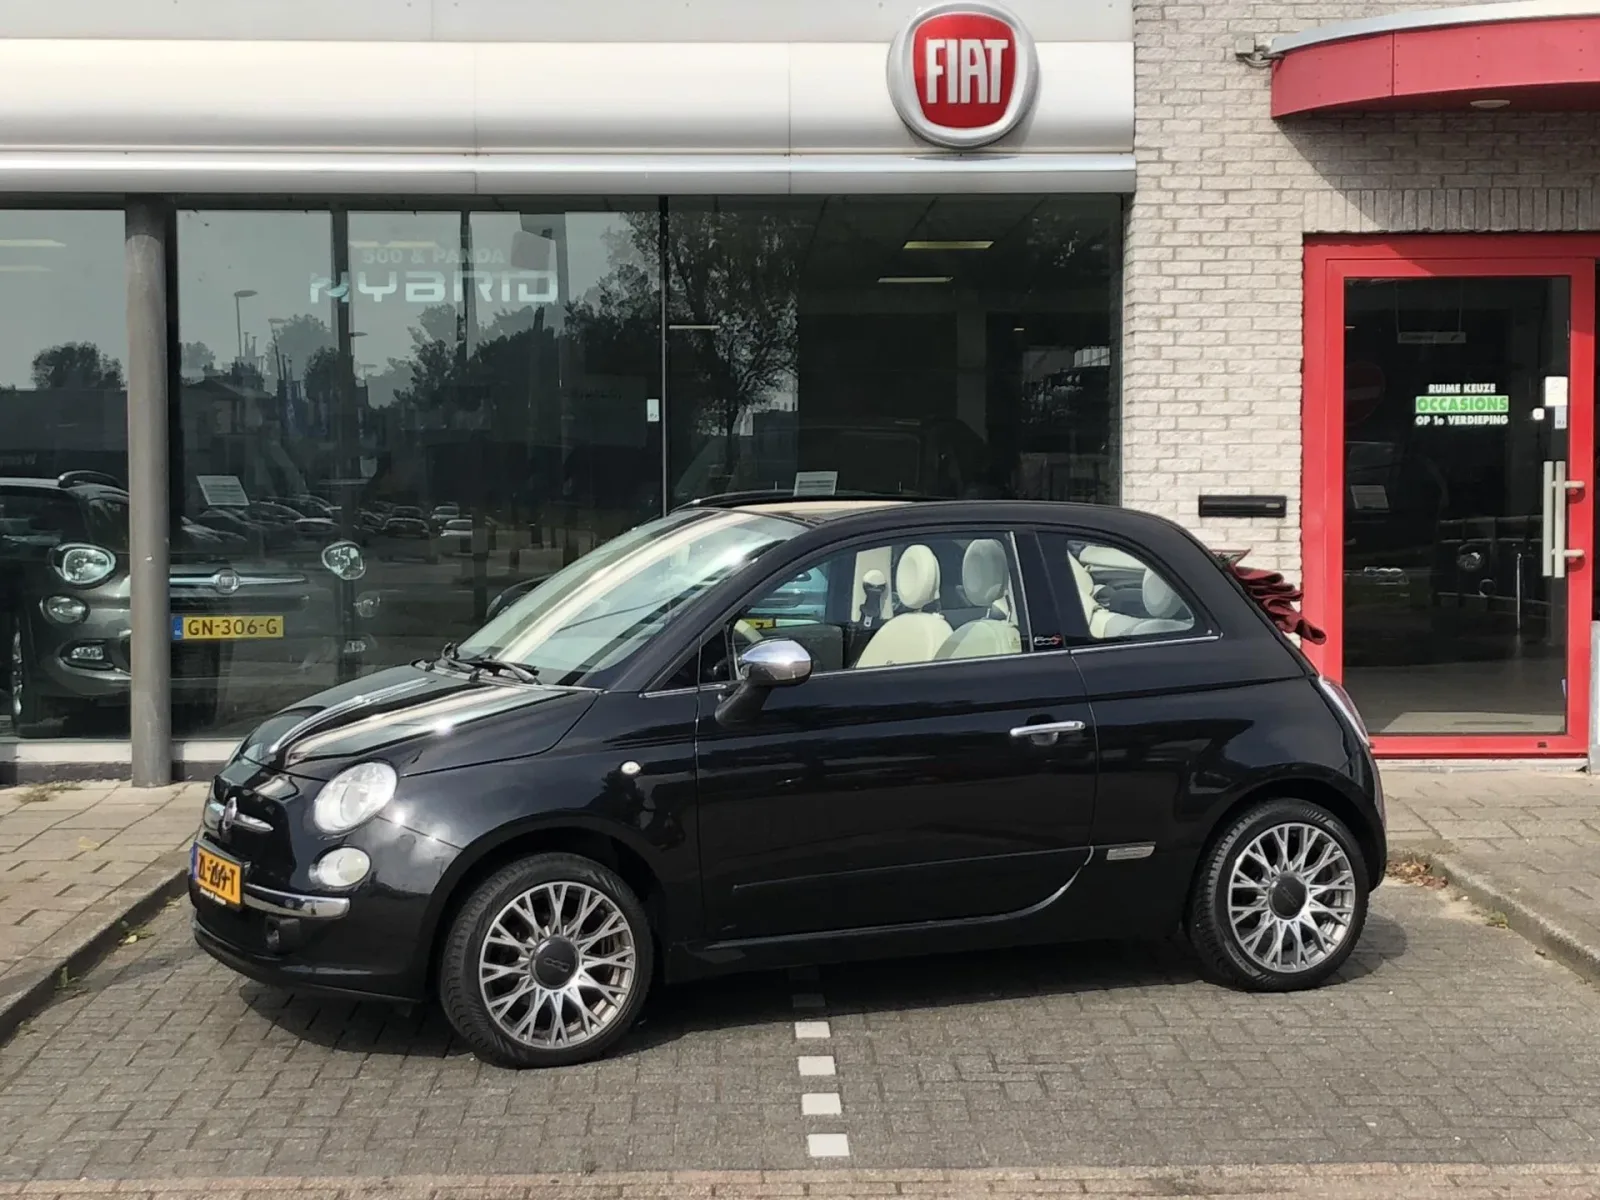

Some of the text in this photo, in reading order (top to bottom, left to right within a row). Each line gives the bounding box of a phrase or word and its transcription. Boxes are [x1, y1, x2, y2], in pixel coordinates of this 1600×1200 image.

[925, 38, 1009, 104] FIAT
[362, 248, 505, 264] 500 & PANDA
[309, 271, 558, 304] HYBRID
[1428, 383, 1496, 394] RUIME KEUZE
[1417, 397, 1508, 411] OCCASIONS
[1415, 415, 1431, 425] OP
[1447, 414, 1509, 425] VERDIEPING
[187, 619, 278, 636] GN-306-G
